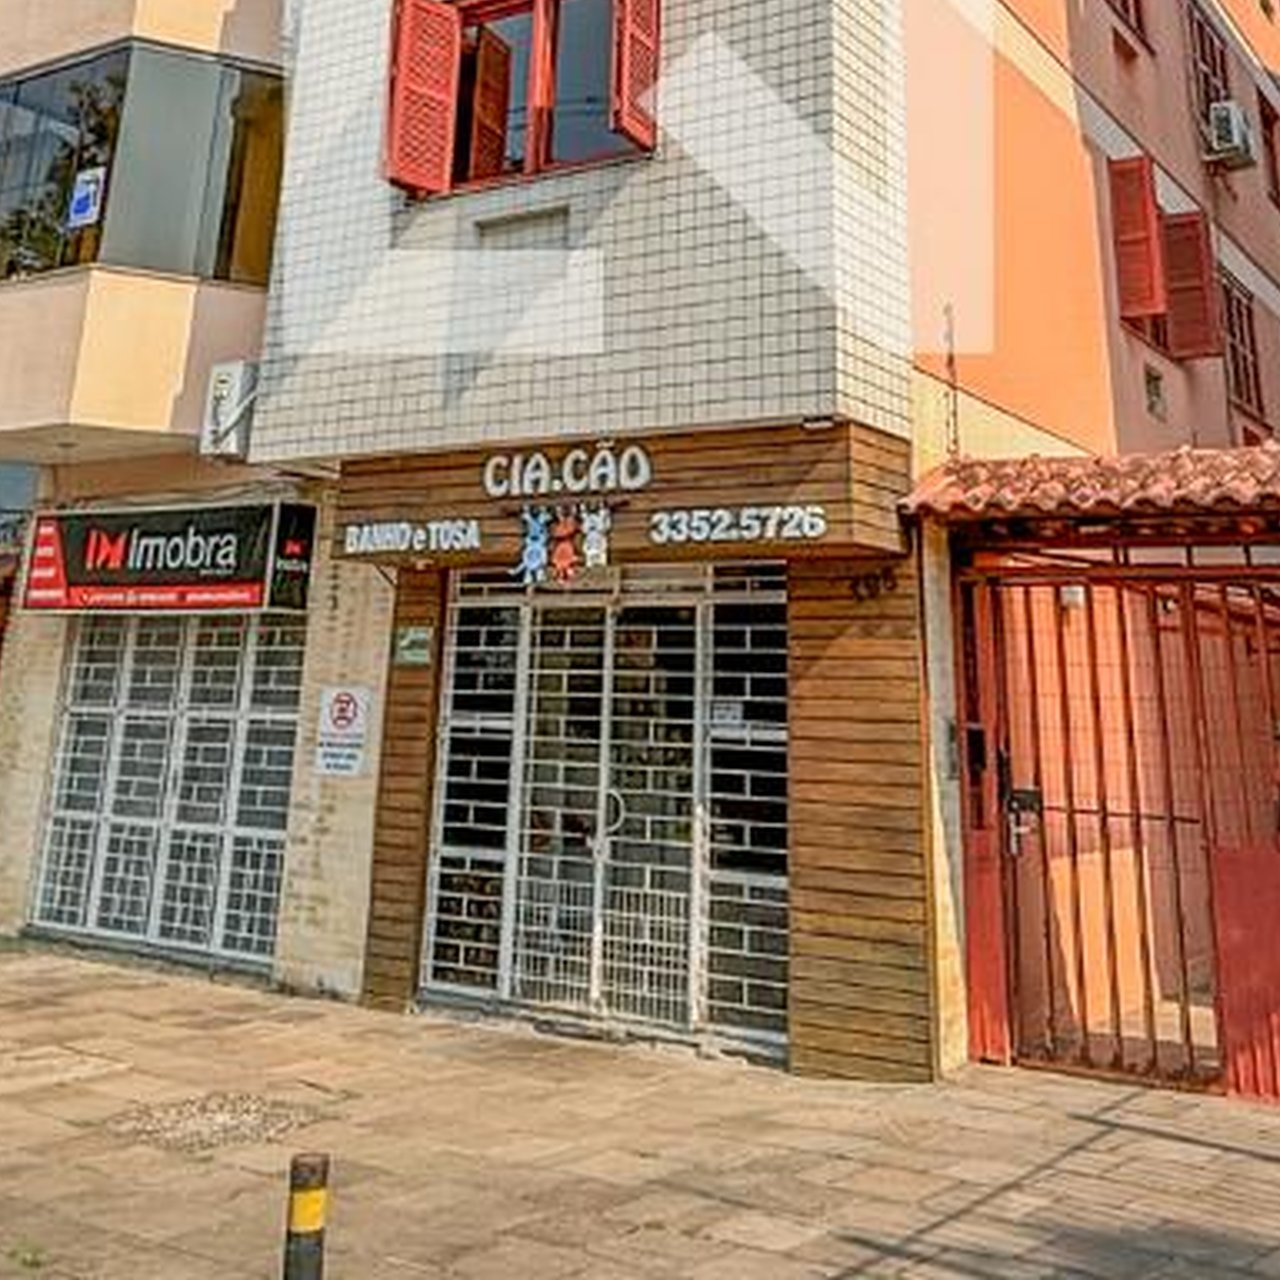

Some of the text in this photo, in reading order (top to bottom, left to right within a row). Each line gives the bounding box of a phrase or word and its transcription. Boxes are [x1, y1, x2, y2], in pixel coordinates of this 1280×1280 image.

[483, 440, 652, 497] CIA.CÃO
[345, 519, 481, 554] BANHO e TOSA
[649, 506, 827, 544] 3352.5726
[128, 525, 237, 570] Imobra
